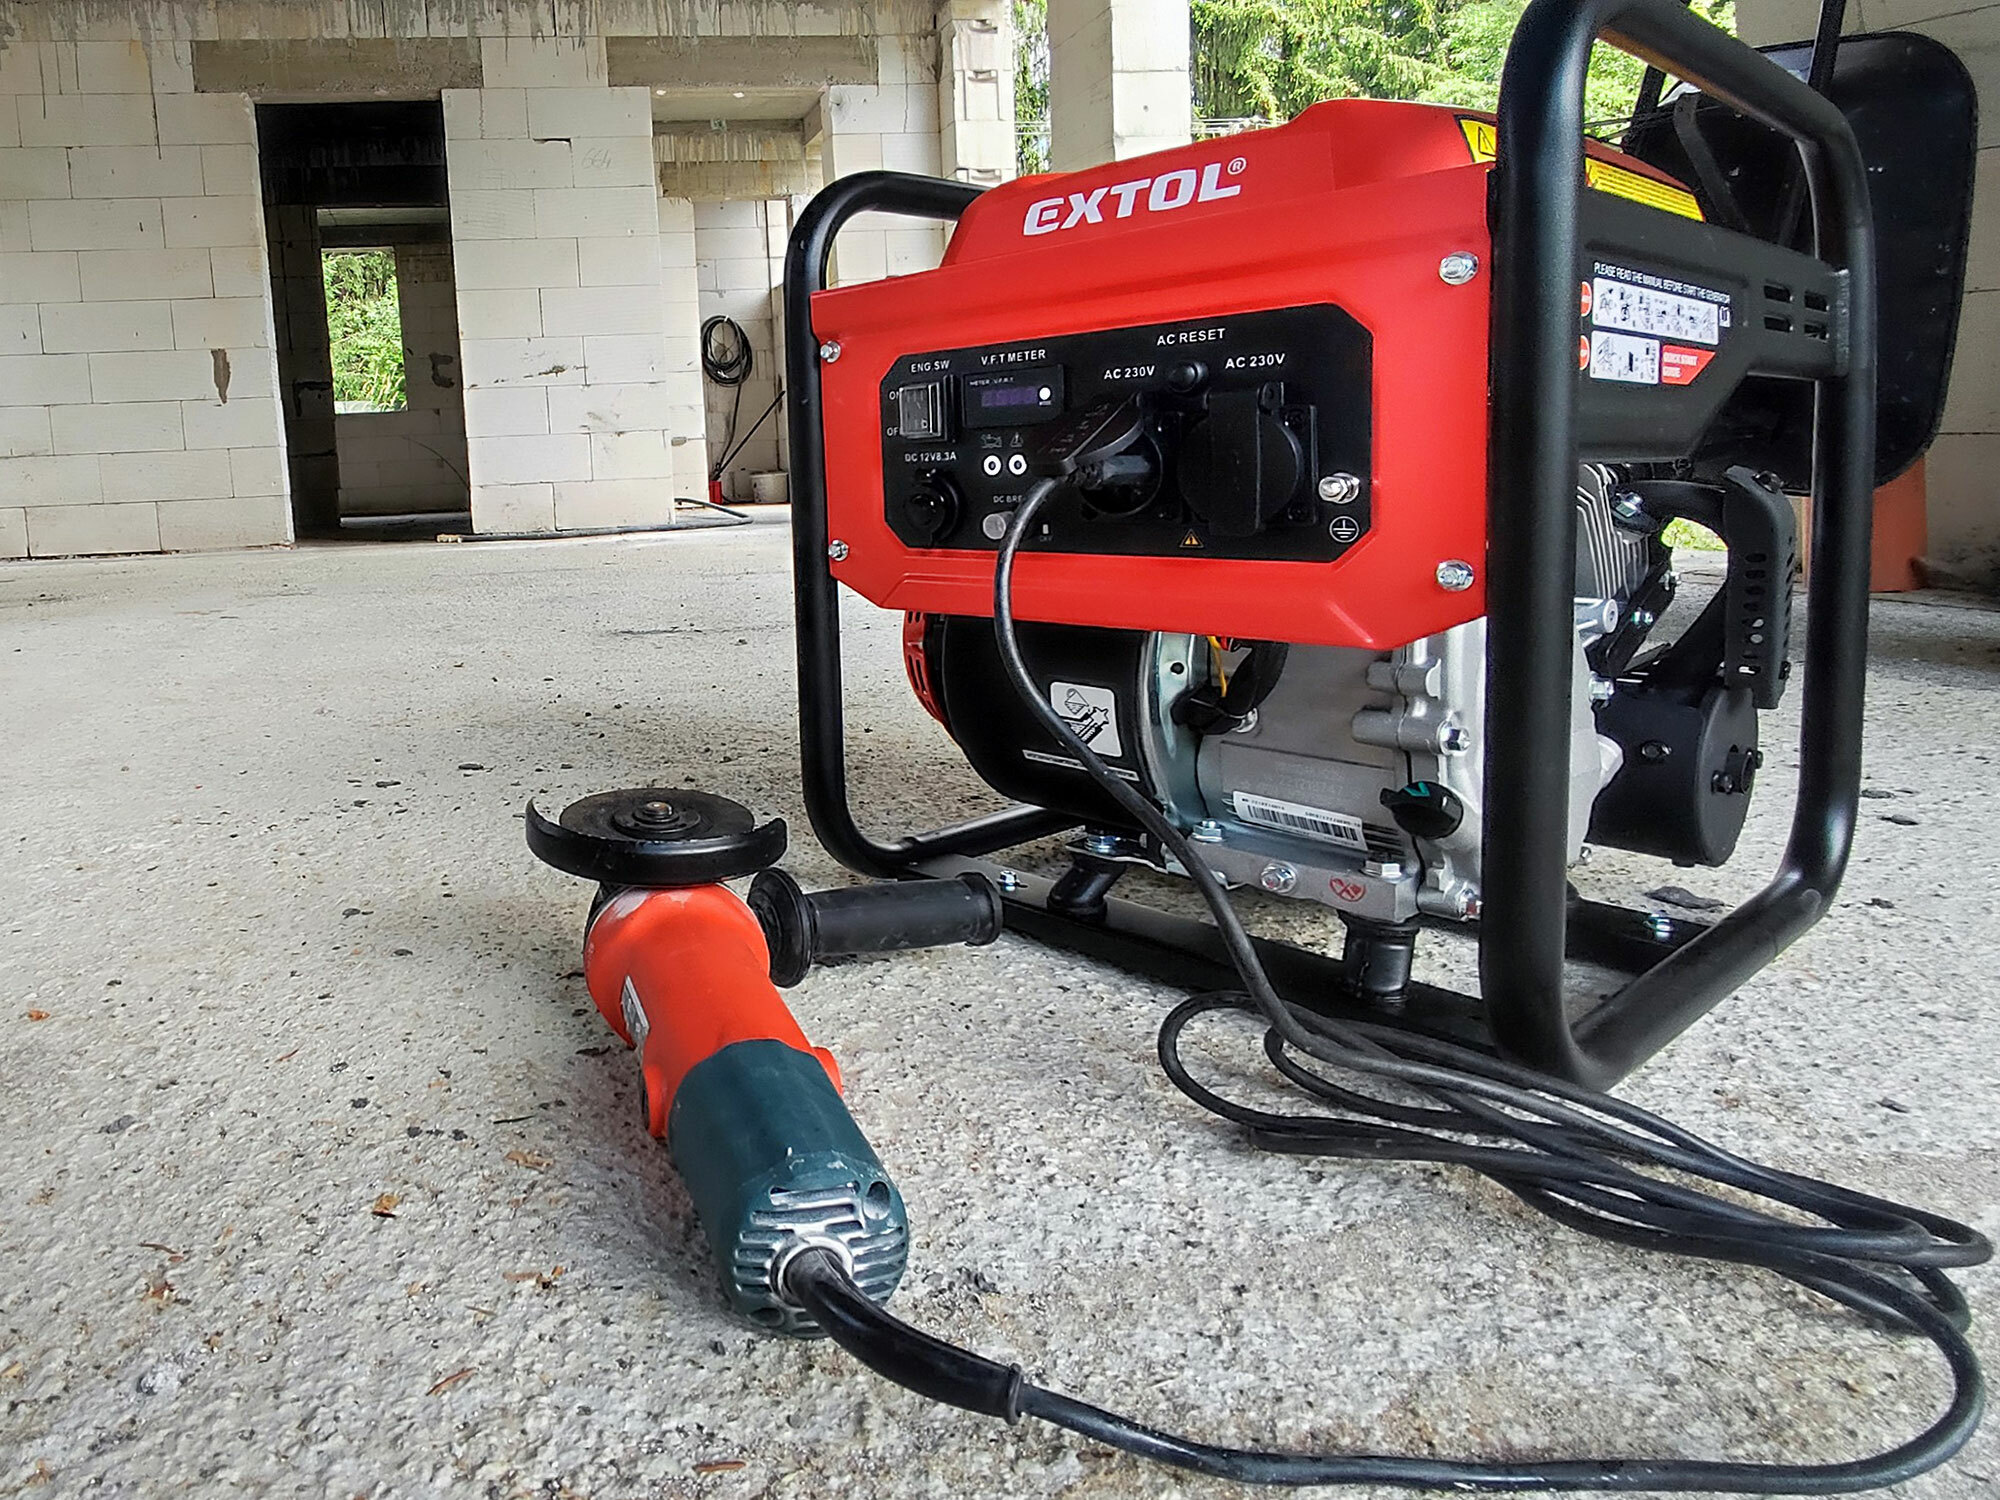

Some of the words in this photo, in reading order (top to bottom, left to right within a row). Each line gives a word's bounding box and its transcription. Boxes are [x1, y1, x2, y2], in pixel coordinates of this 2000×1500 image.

[1594, 261, 1616, 278] PLEASE
[1616, 267, 1632, 281] READ
[1156, 333, 1176, 347] AC
[1179, 327, 1226, 343] RESET
[1007, 349, 1046, 363] METER
[1225, 356, 1246, 370] AC
[1249, 353, 1286, 368] 230V
[1103, 368, 1121, 380] AC
[1124, 365, 1156, 379] 230V
[886, 427, 899, 437] OF
[904, 453, 918, 462] DC
